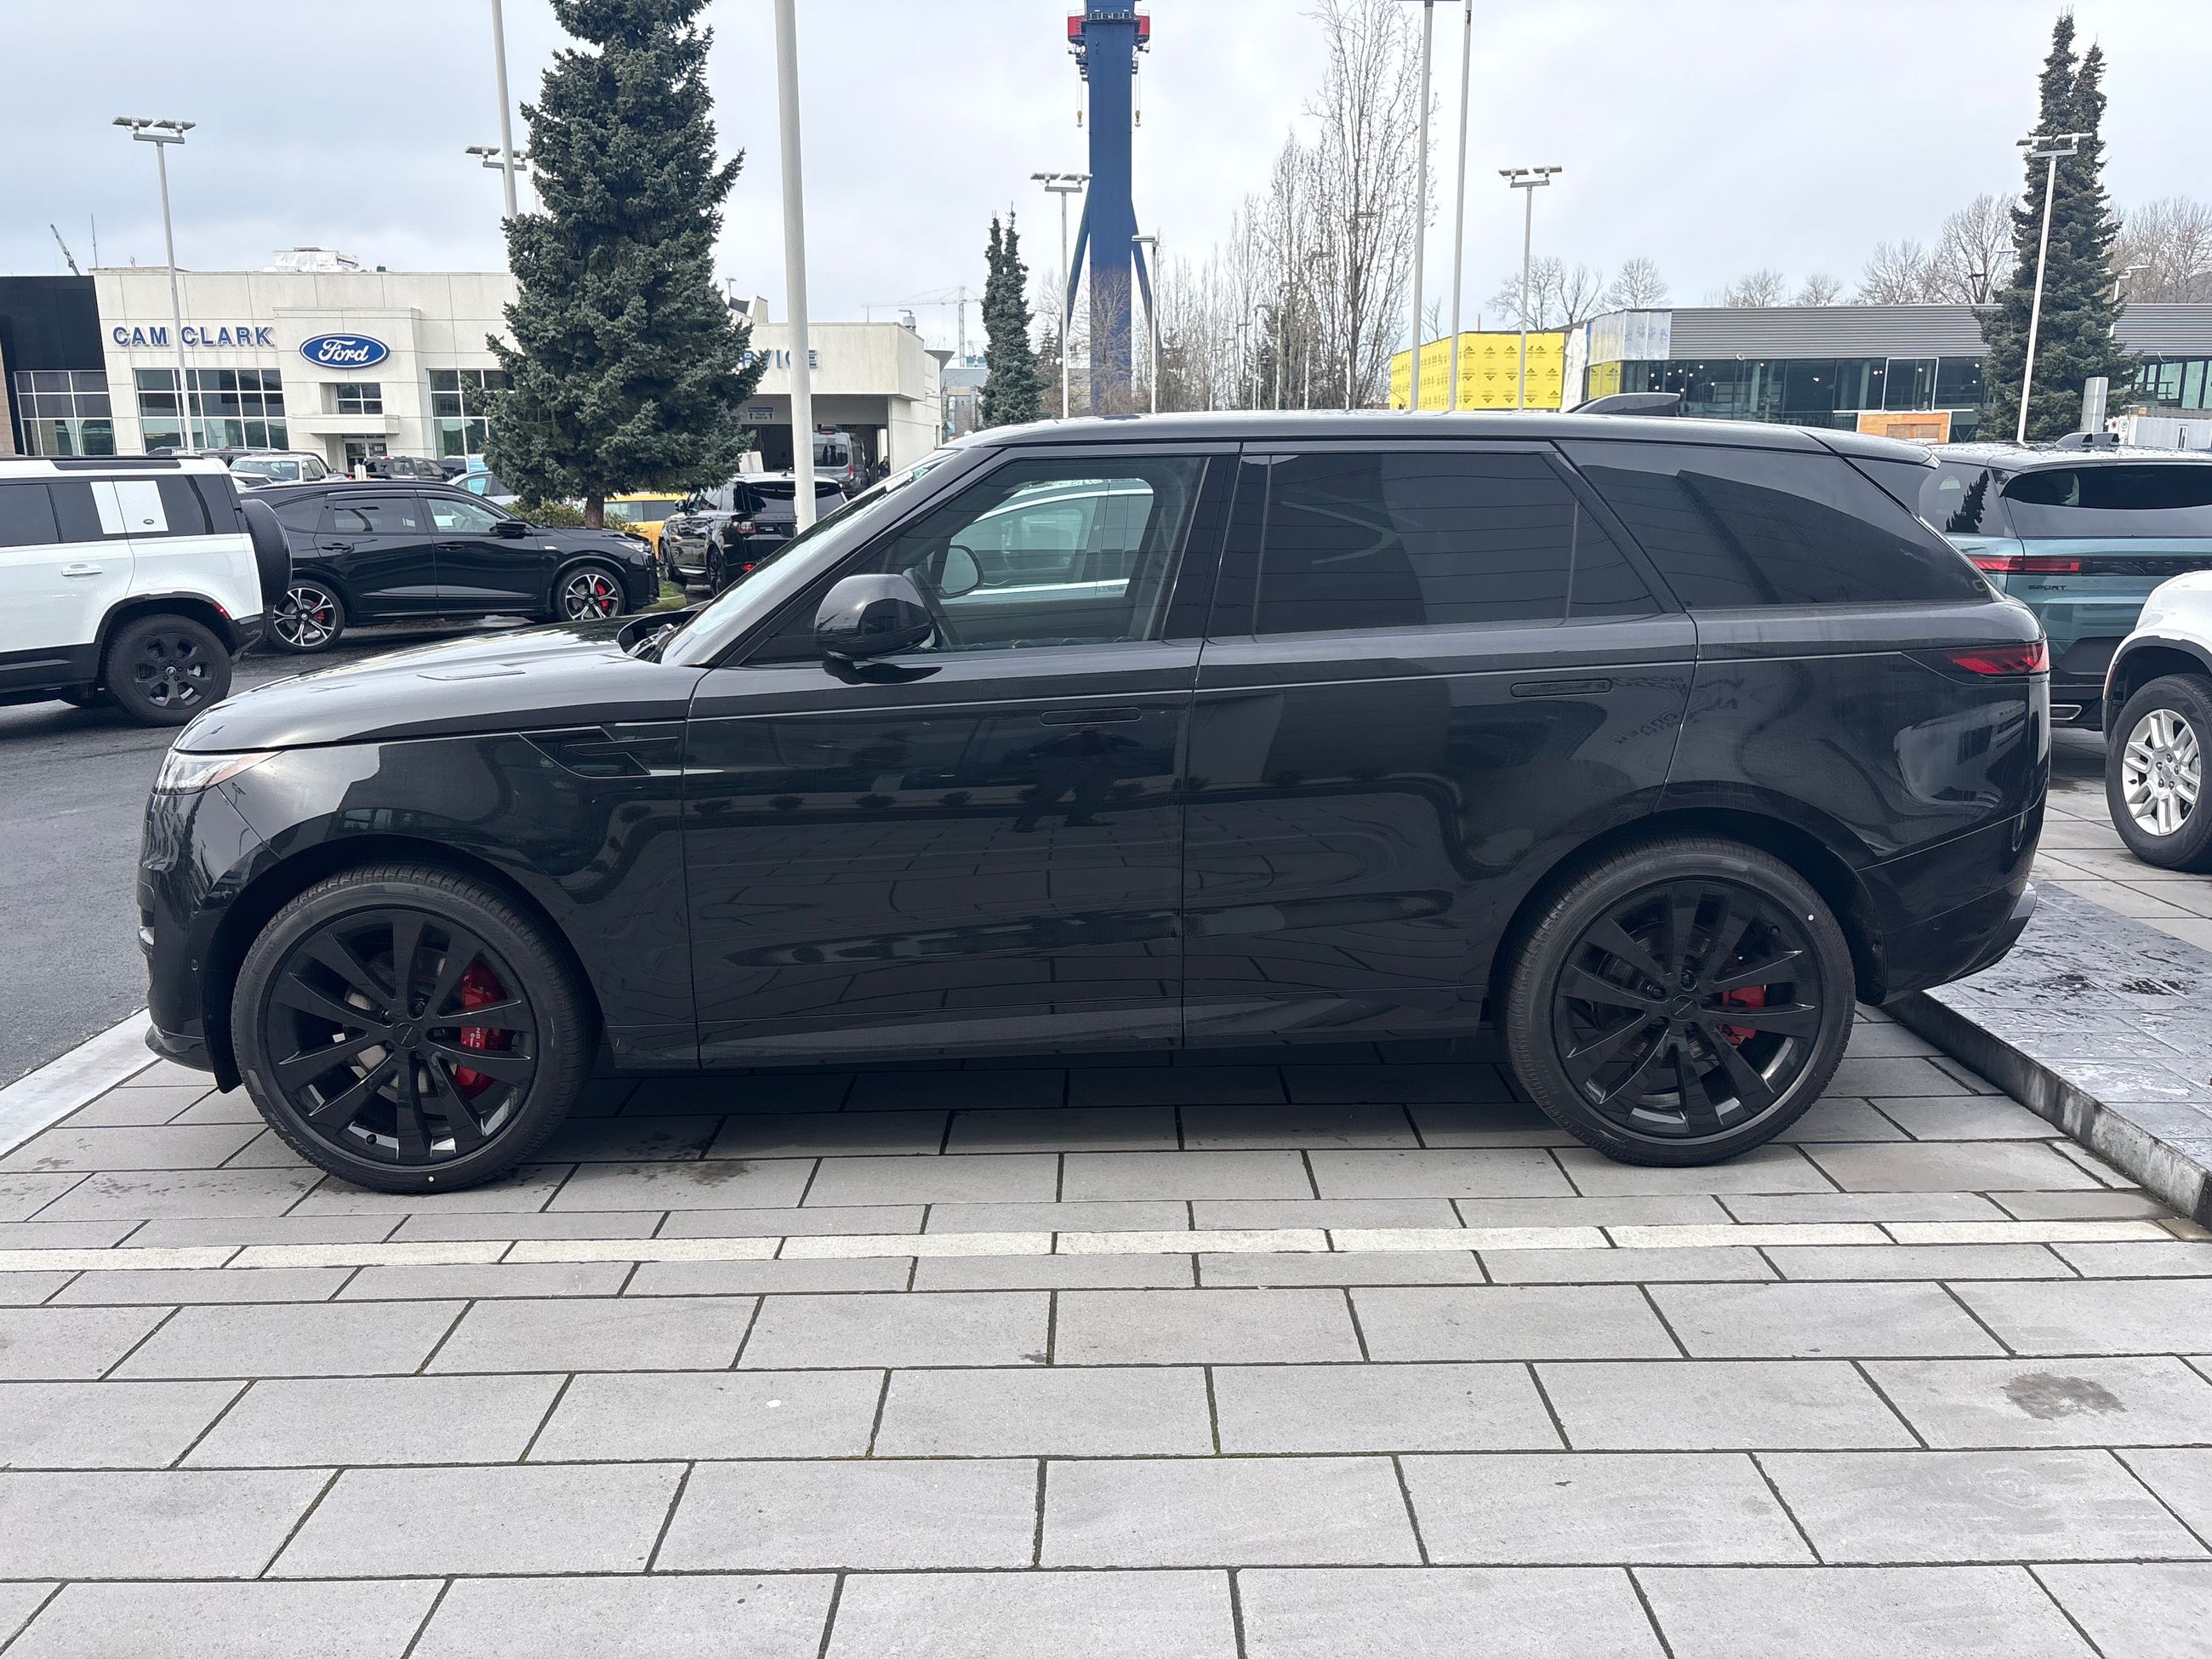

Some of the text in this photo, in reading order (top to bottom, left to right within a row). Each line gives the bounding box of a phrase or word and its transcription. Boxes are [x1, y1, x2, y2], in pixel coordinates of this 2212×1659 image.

[113, 327, 273, 345] CAM CLARK
[318, 339, 369, 362] Ford
